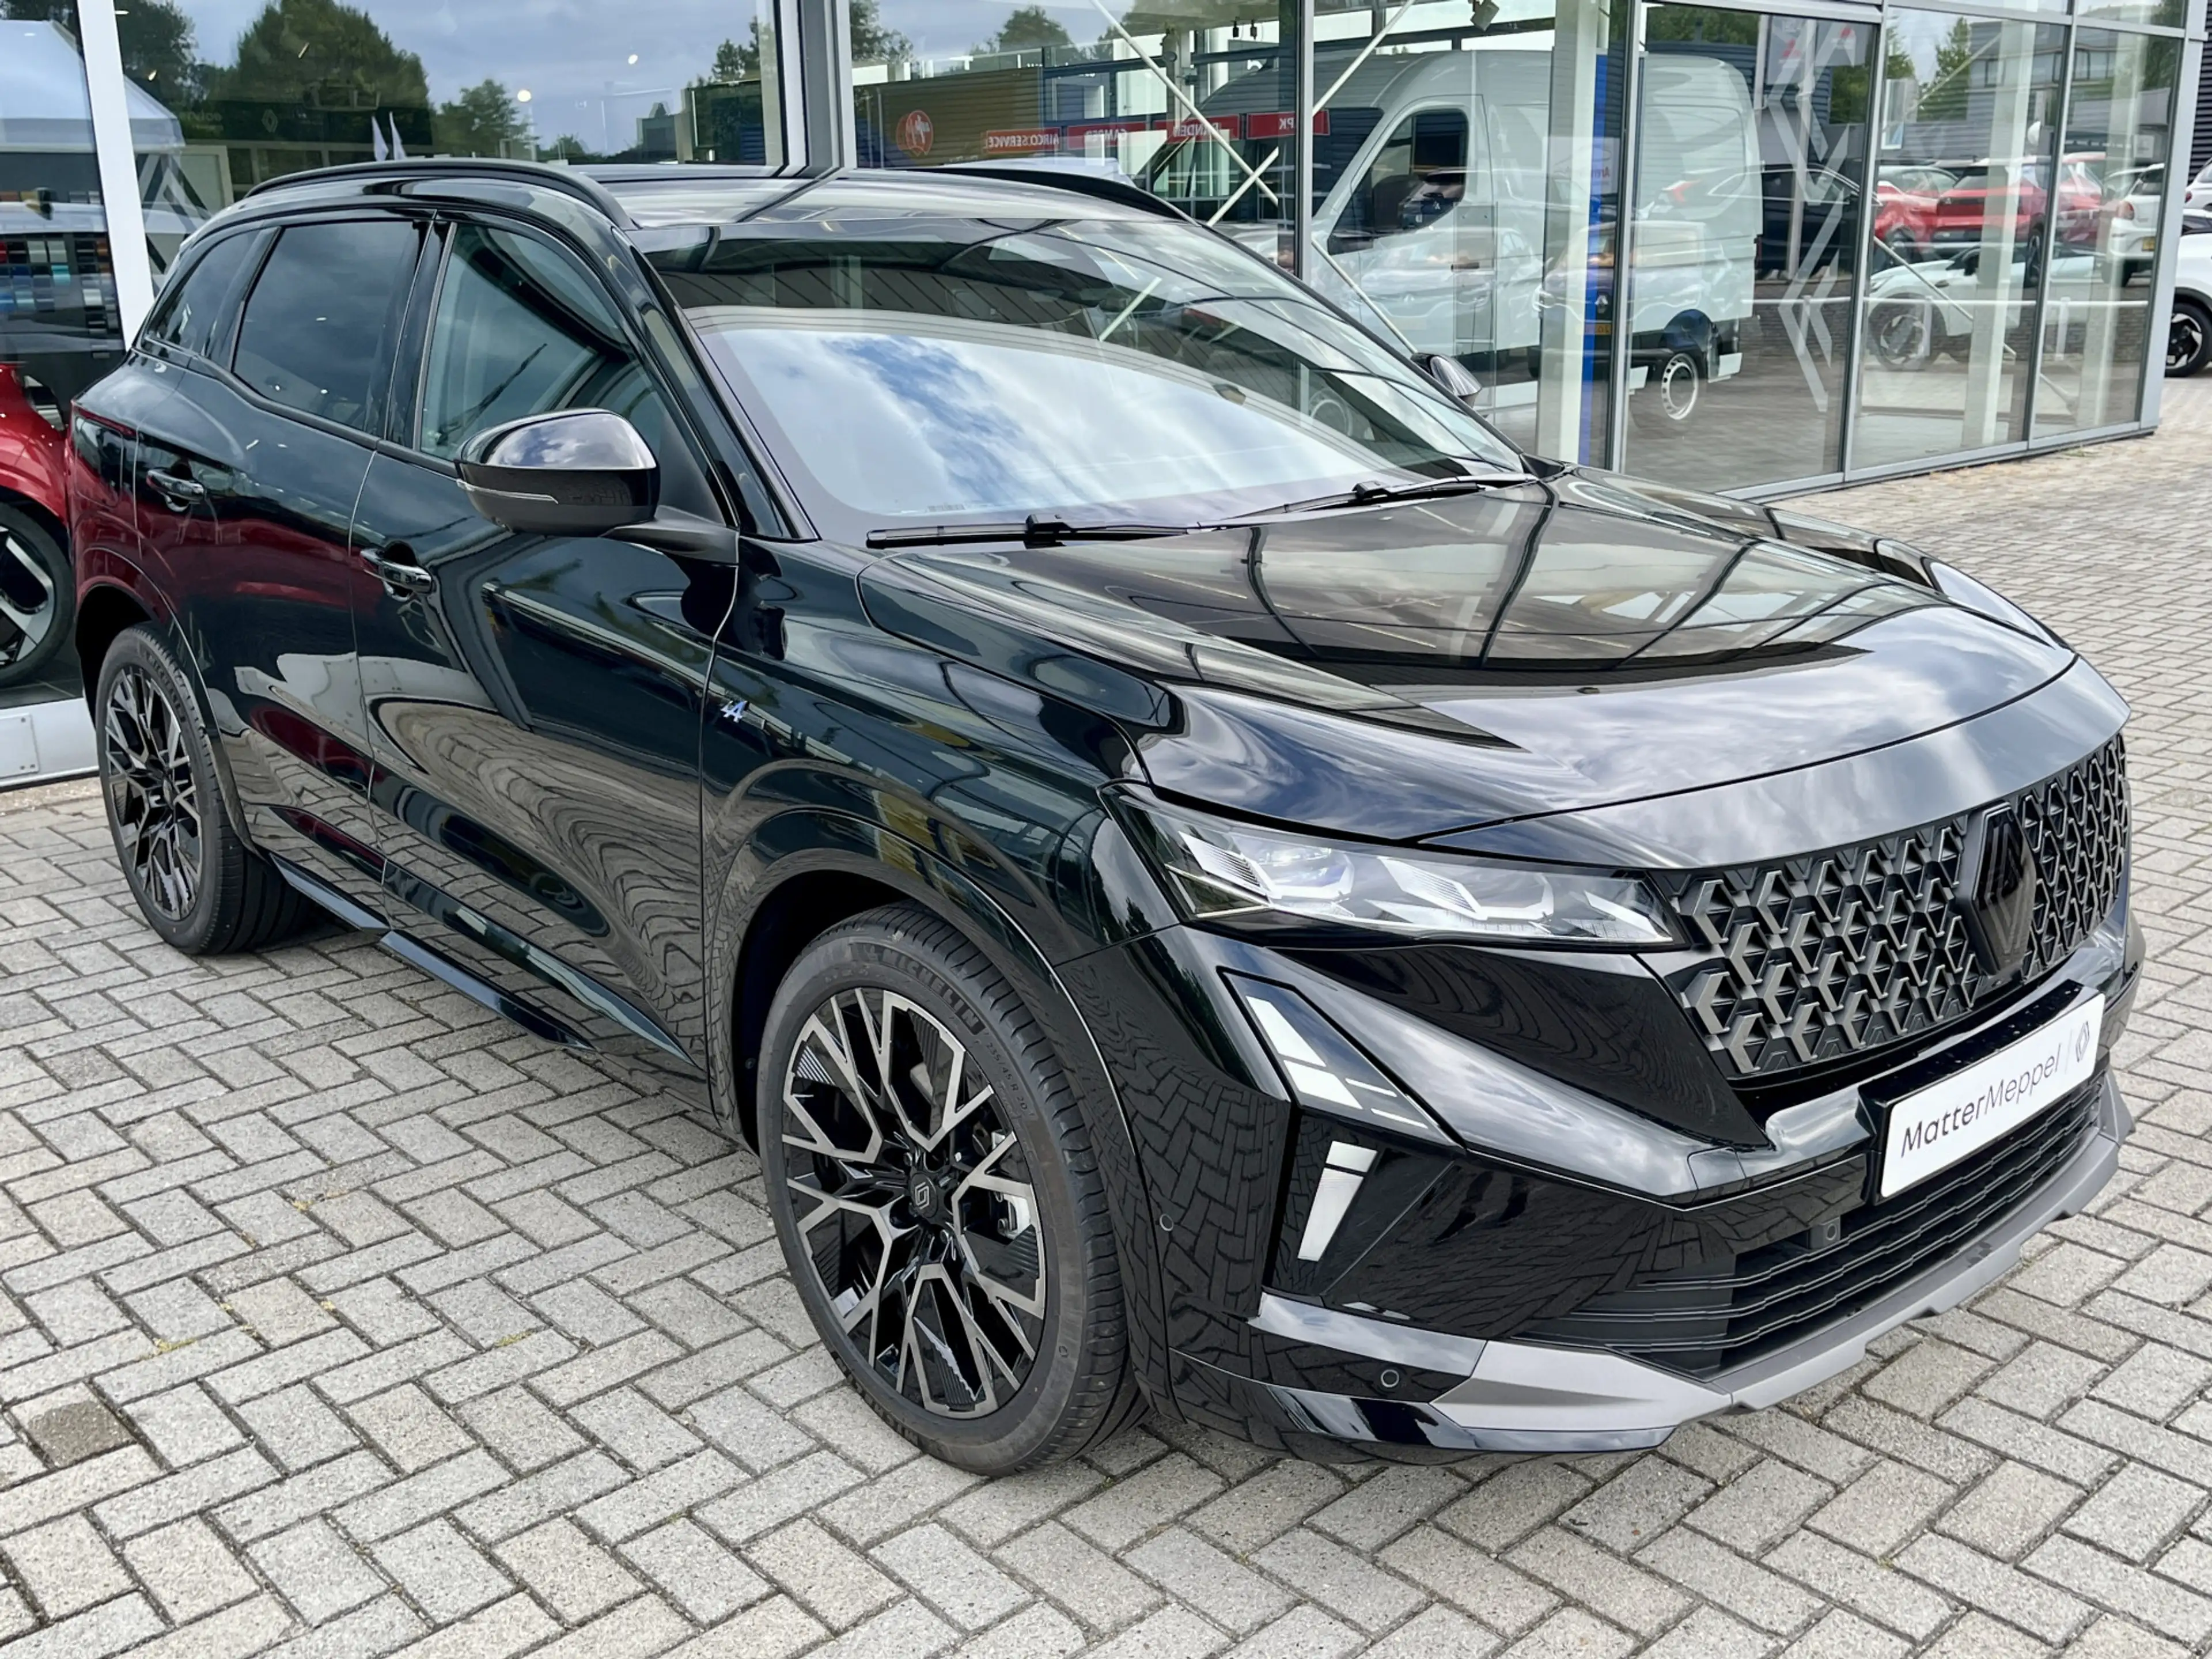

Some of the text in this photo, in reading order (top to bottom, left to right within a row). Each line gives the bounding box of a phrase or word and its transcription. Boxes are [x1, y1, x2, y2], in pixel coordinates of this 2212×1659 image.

[882, 948, 978, 1029] MICHELIN
[986, 1042, 1013, 1081] 235/45
[1900, 1043, 2062, 1158] MatterMeppel
